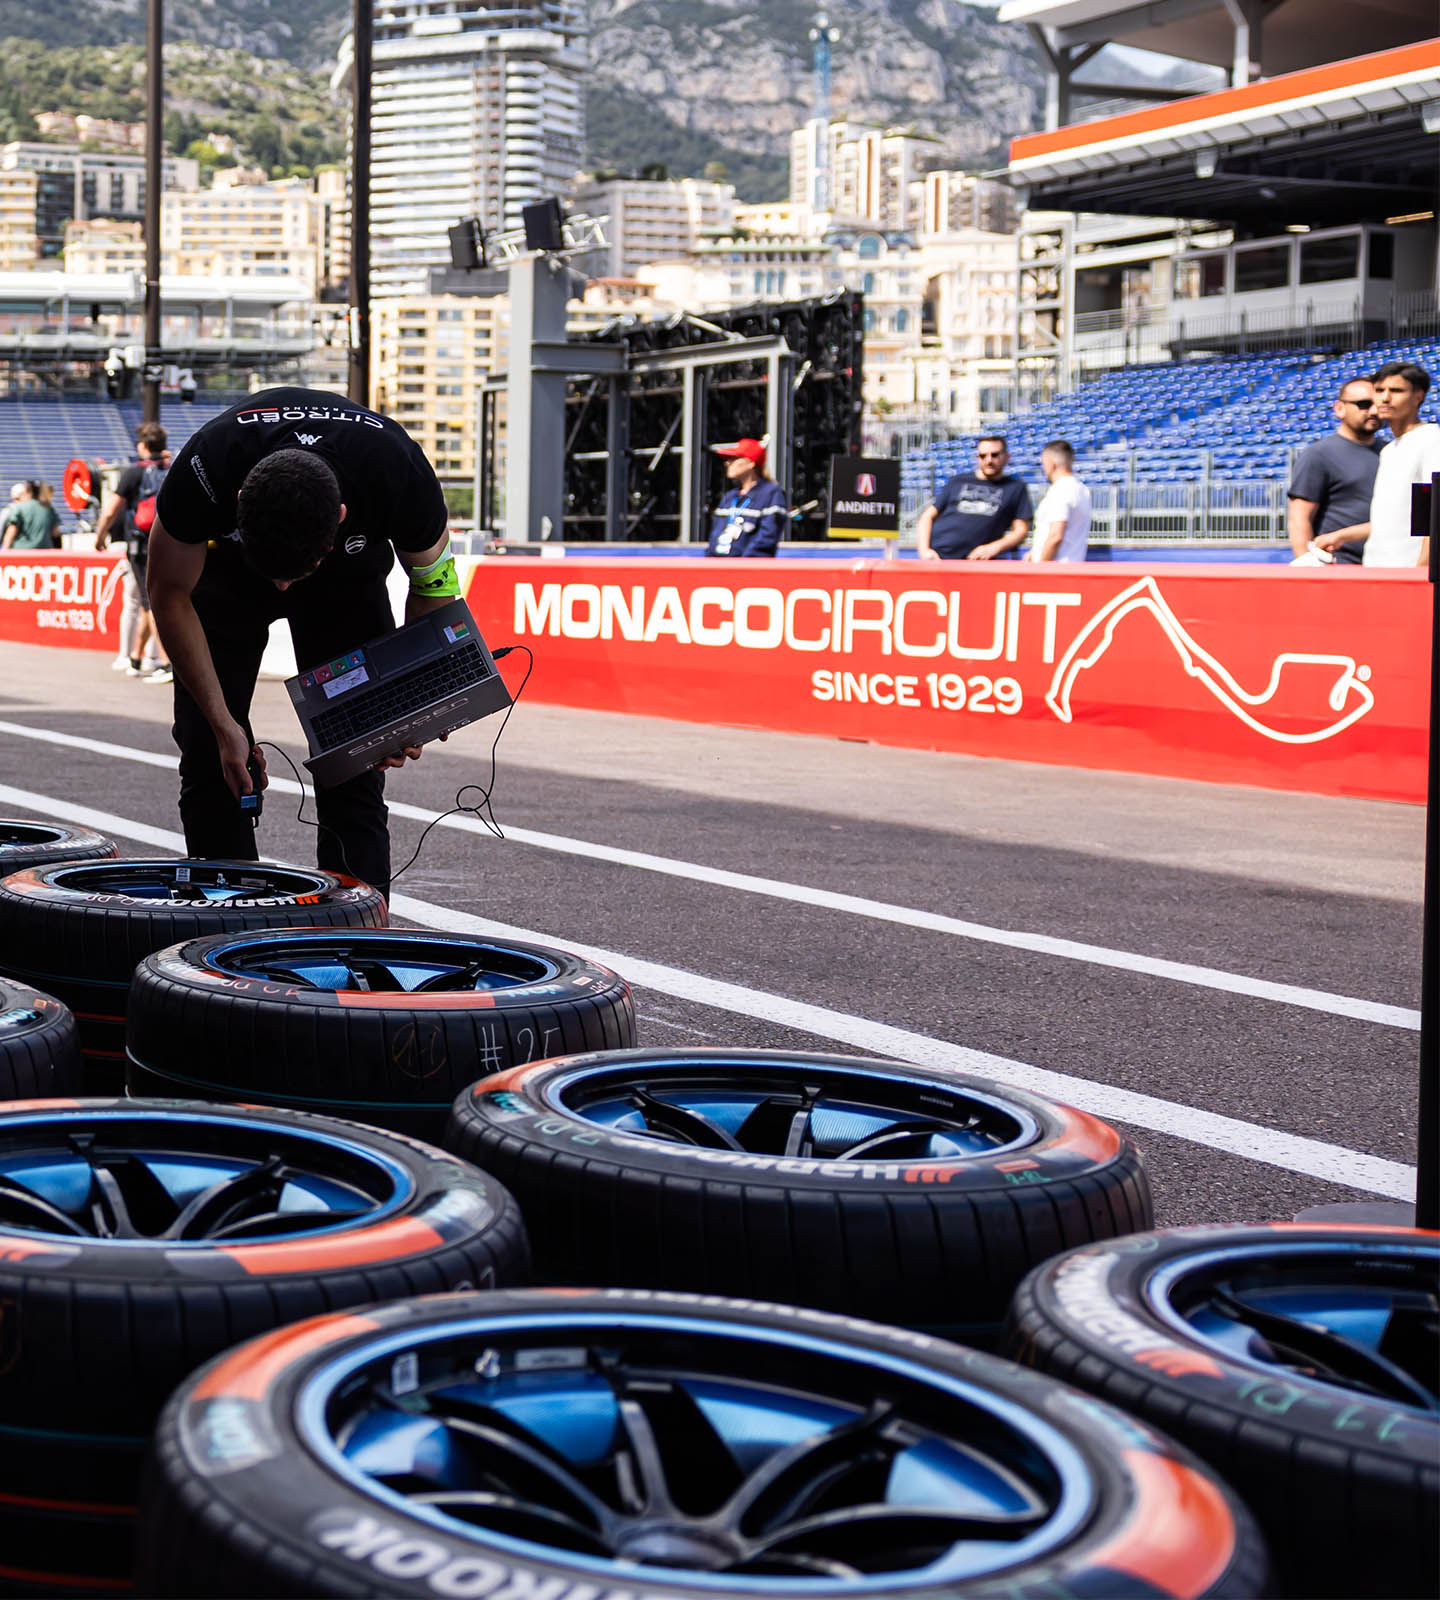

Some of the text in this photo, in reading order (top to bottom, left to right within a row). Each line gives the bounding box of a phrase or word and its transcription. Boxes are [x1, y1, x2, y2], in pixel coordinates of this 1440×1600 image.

[835, 500, 895, 516] ANDRETTI
[812, 669, 1024, 716] SINCE 1929
